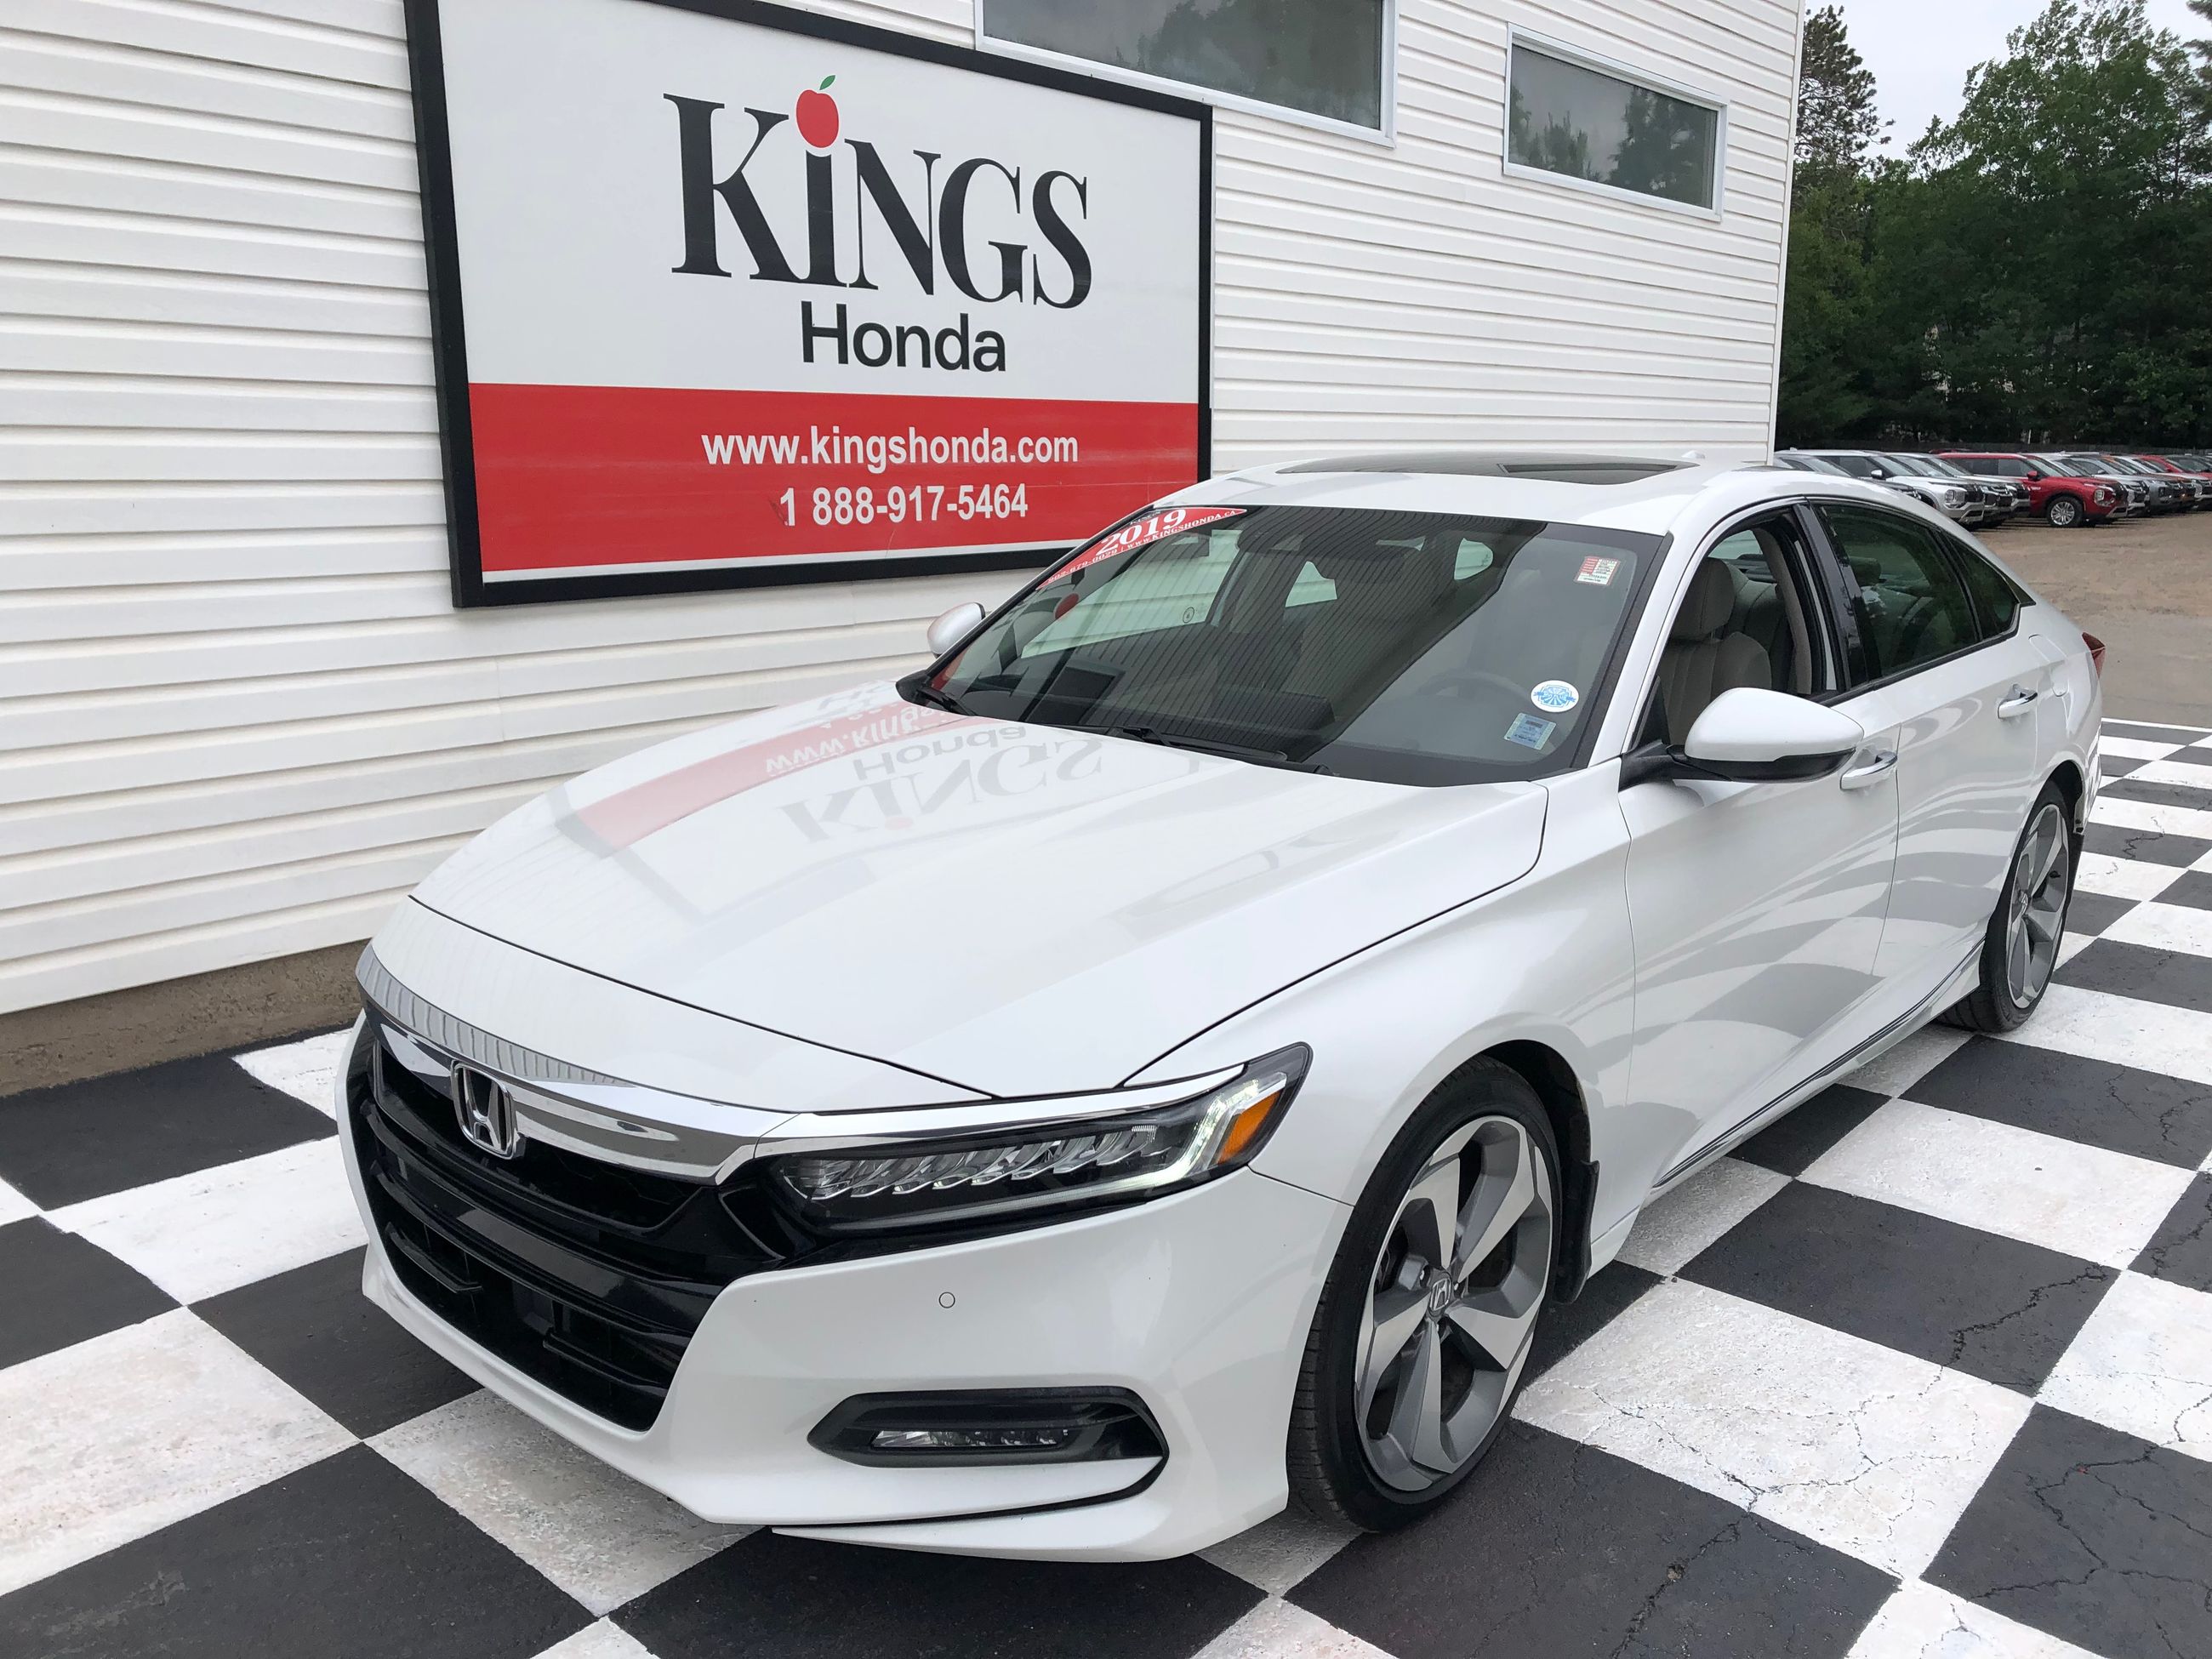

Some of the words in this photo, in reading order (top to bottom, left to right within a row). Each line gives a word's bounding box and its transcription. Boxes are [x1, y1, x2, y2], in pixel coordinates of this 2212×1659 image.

[801, 300, 1006, 373] Honda
[702, 426, 1078, 473] www.kingshonda.com
[780, 487, 796, 527] 1
[812, 483, 1028, 525] 888-917-5464
[1095, 509, 1187, 556] 2019
